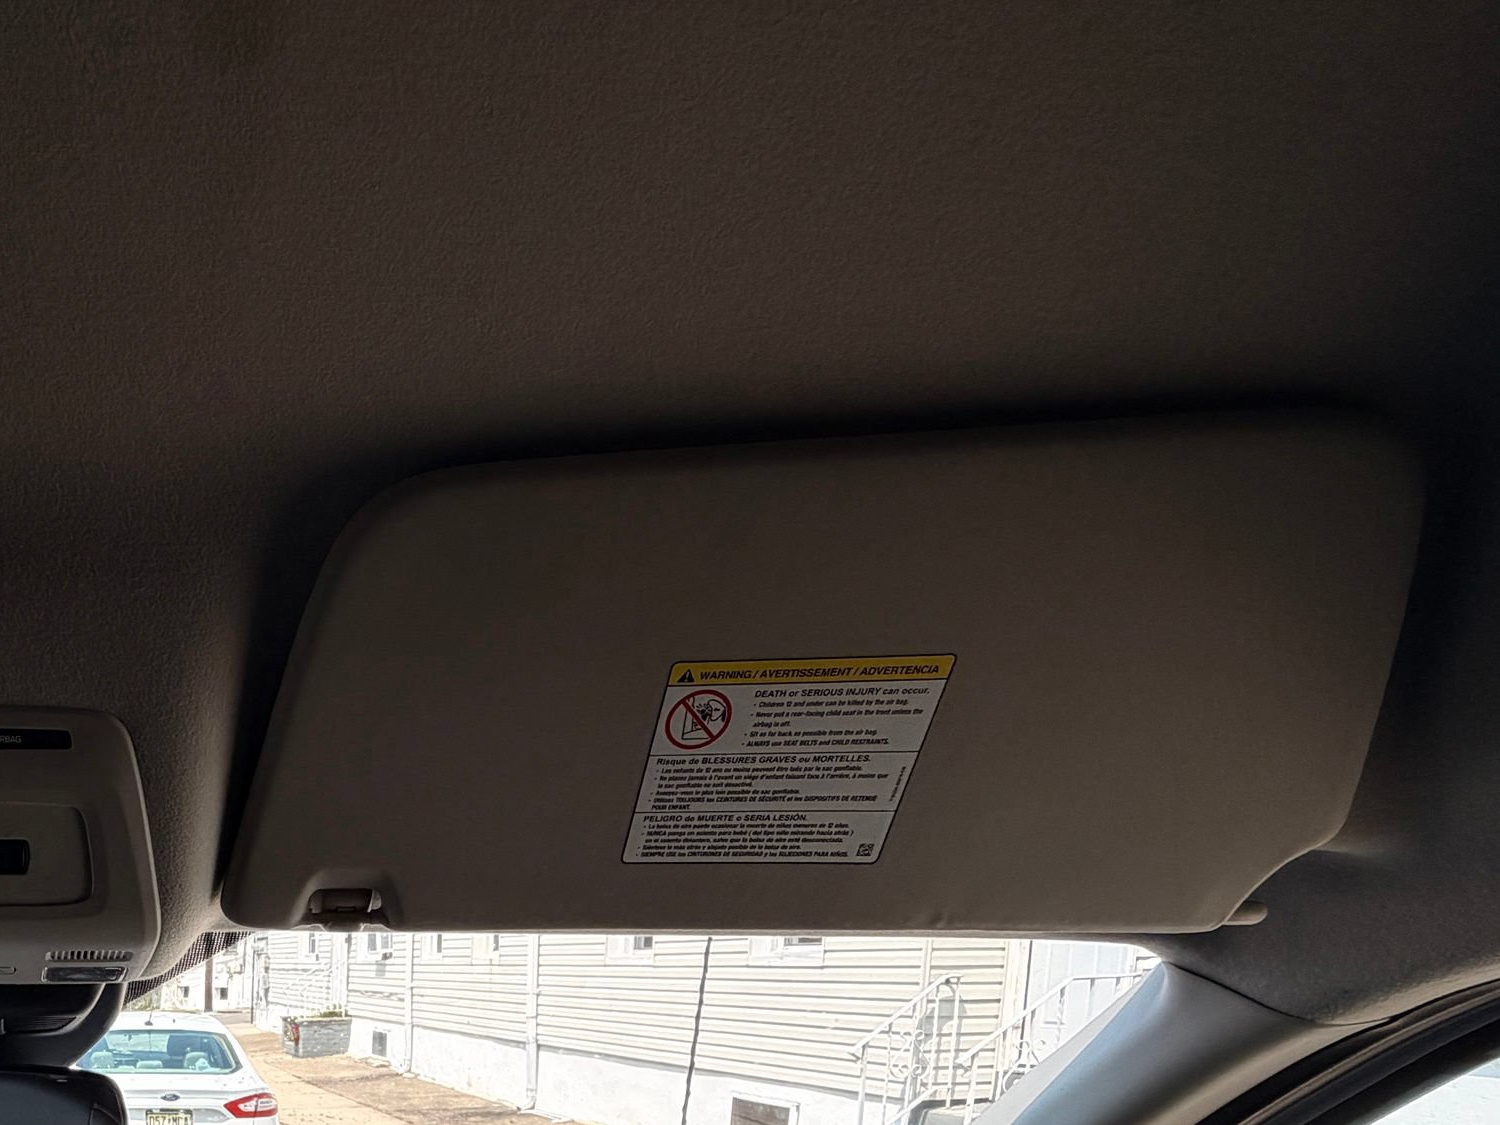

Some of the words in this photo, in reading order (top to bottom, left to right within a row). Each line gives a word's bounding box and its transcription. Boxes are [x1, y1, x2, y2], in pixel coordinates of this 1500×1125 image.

[700, 670, 752, 680] WARNING
[759, 668, 852, 678] AVERTISSEMENT
[859, 665, 939, 676] ADVERTENCIA
[755, 690, 787, 698] DEATH
[801, 688, 843, 697] SERIOUS
[845, 688, 881, 696] INJURY
[657, 758, 686, 766] Risque
[812, 754, 871, 763] MORTELLES.
[697, 814, 735, 822] MUERTE
